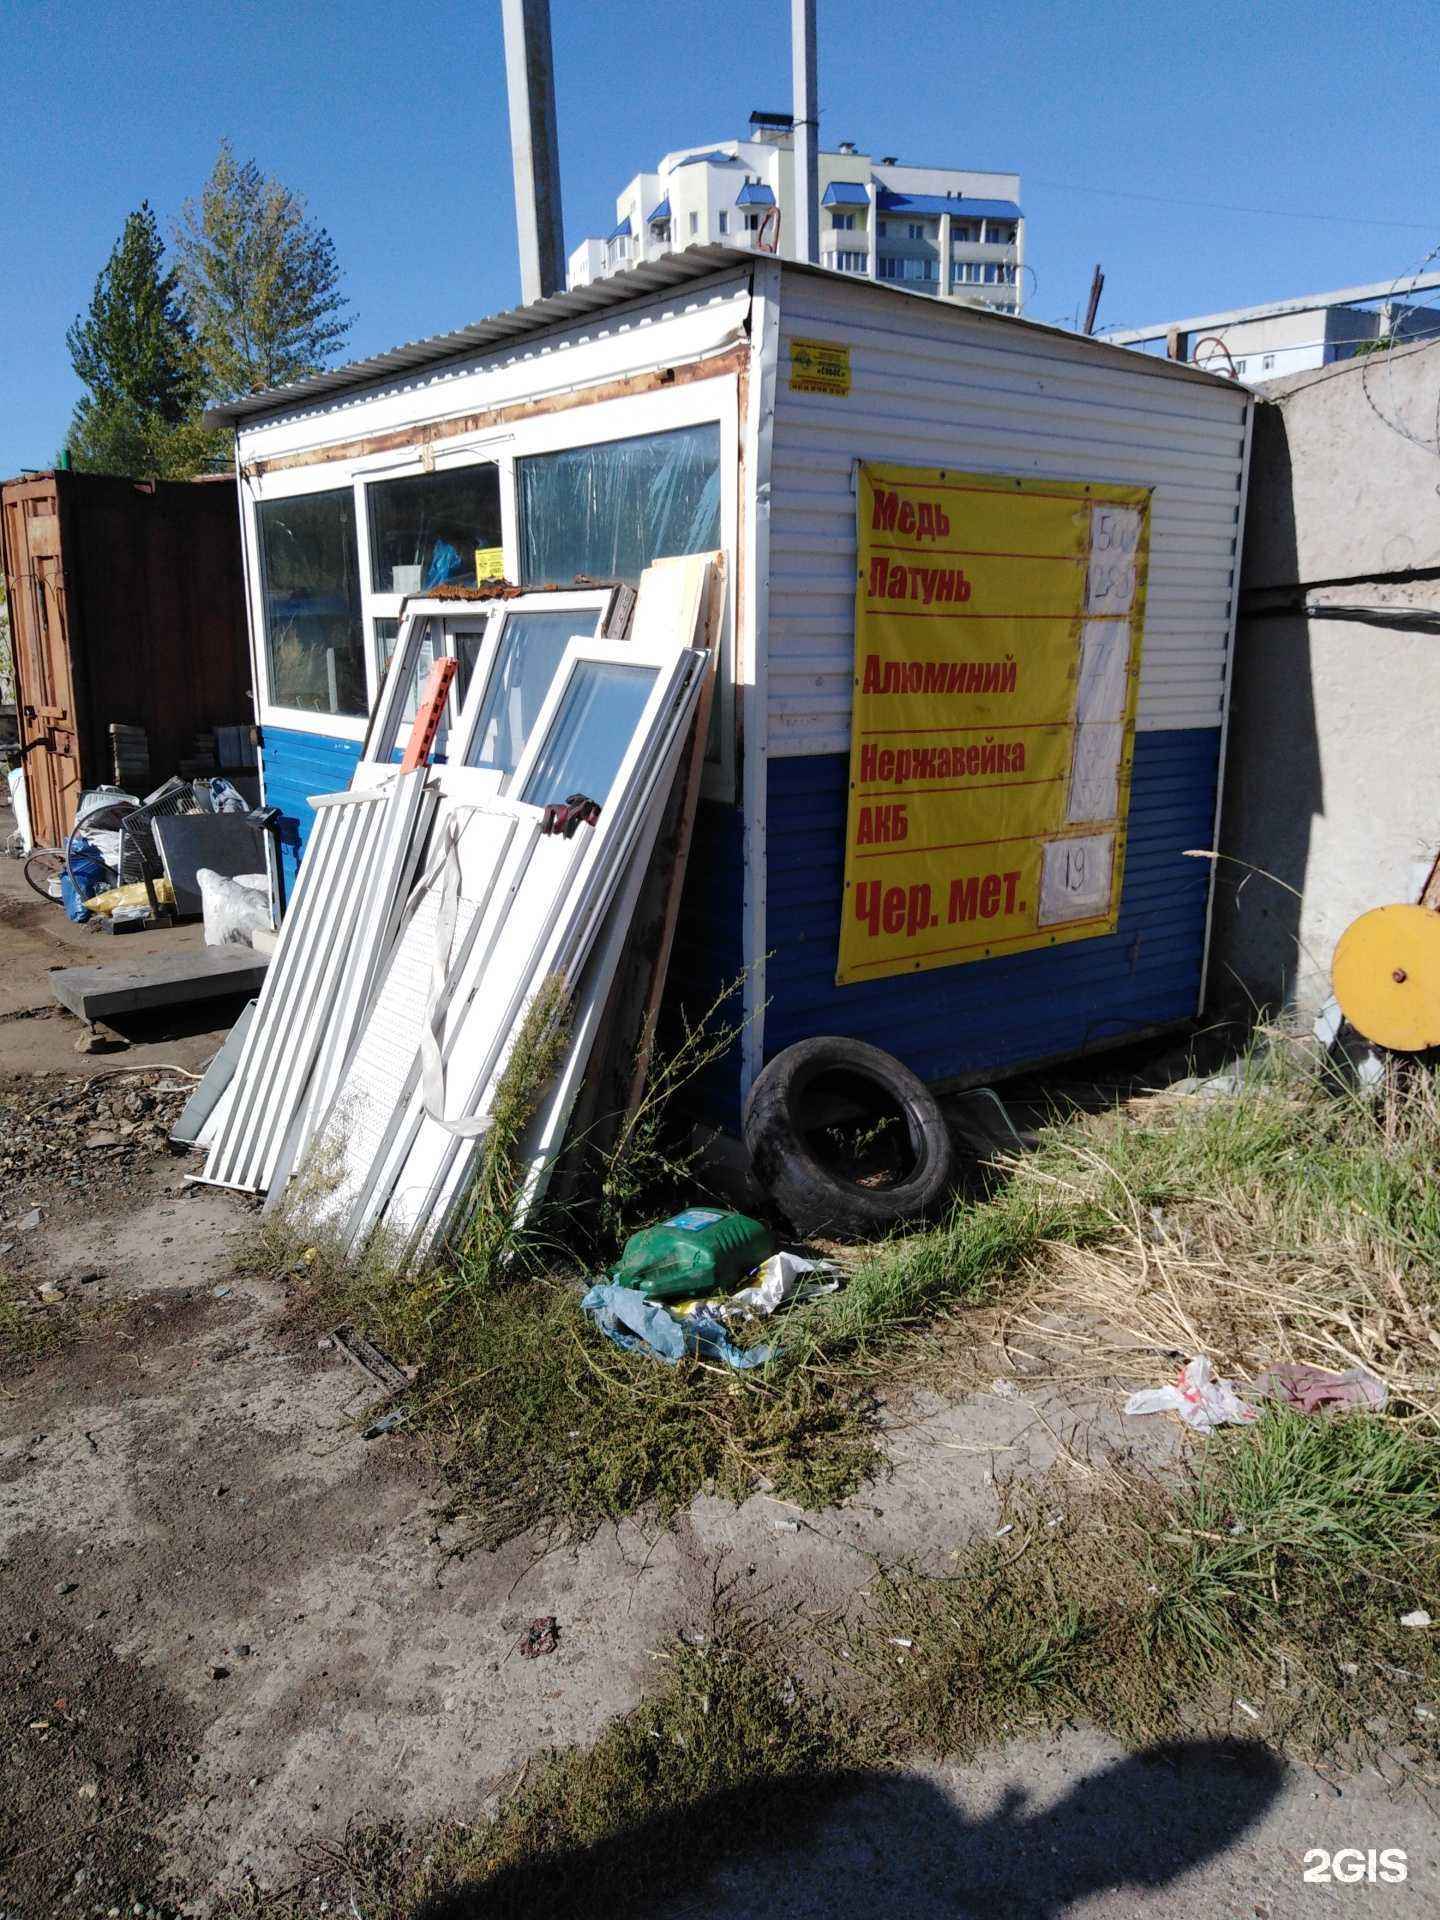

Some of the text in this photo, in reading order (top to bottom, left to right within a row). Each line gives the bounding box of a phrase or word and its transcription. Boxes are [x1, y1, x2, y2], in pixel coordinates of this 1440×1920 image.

[871, 488, 950, 542] Медь
[867, 556, 972, 605] Латунь
[861, 653, 1017, 695] Алюминий
[859, 736, 1026, 785] Нержавейка
[856, 803, 909, 846] АКБ
[1064, 847, 1086, 891] 19
[855, 870, 1027, 937] Чер. мет.
